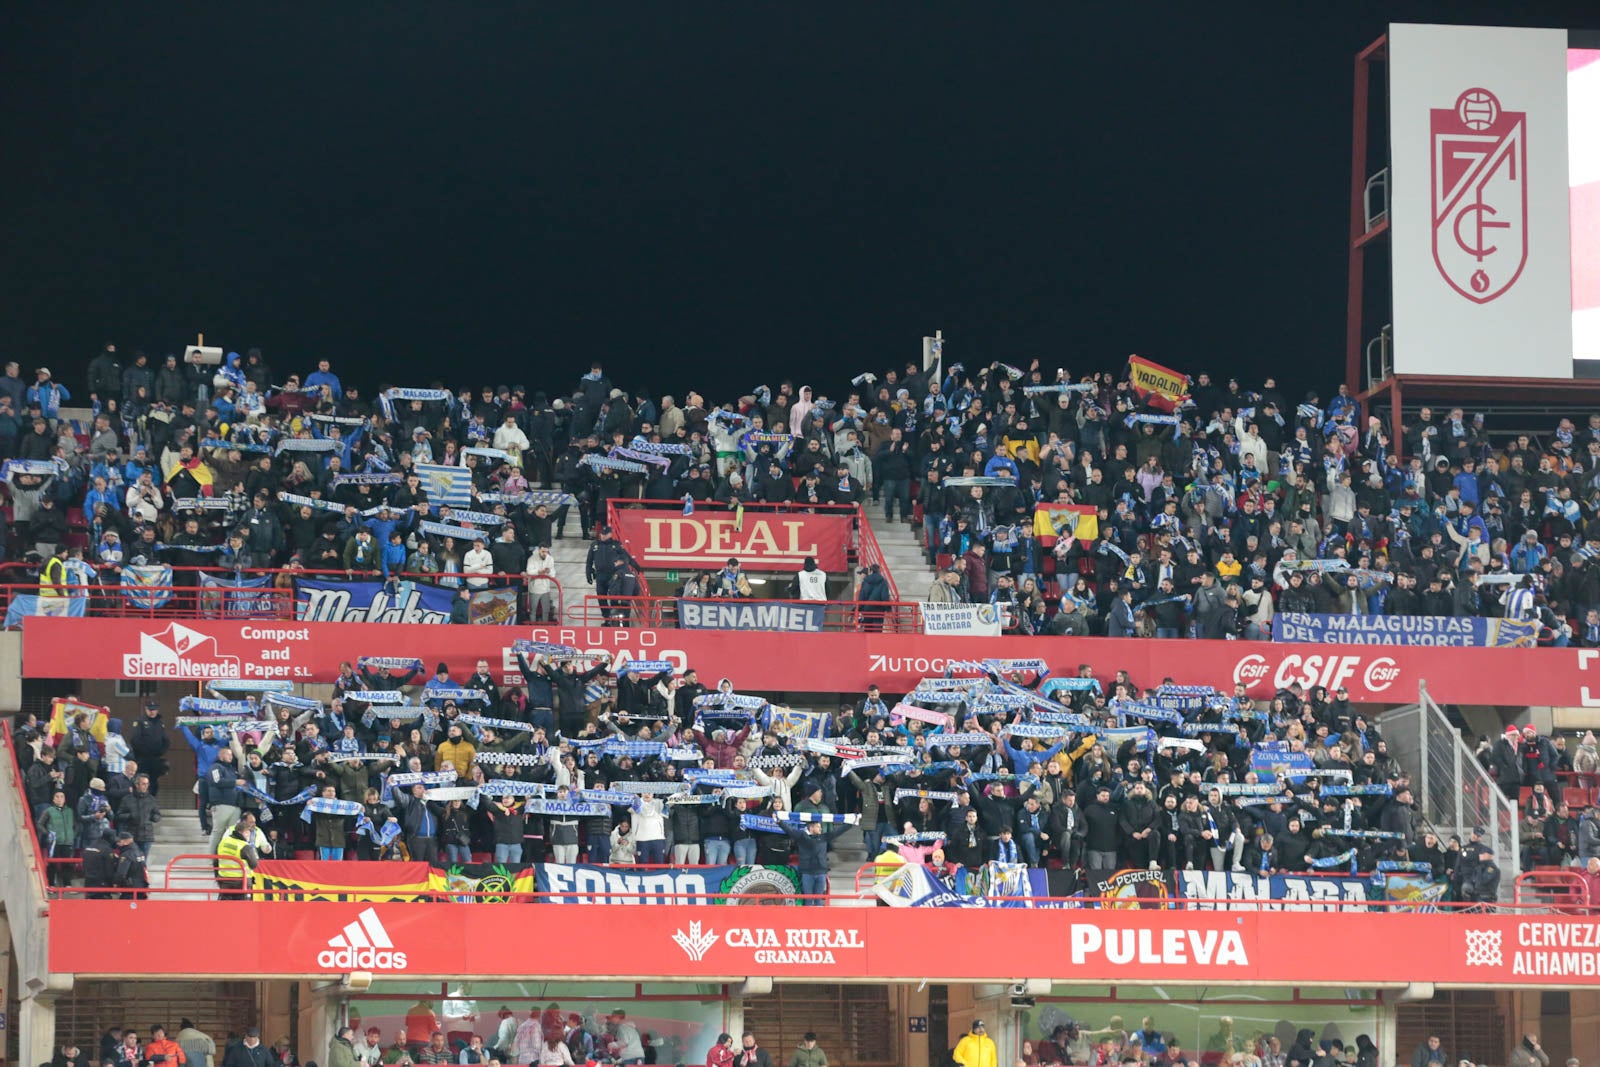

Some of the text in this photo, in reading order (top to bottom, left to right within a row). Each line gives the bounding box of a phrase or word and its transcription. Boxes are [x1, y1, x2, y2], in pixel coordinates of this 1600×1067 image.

[750, 434, 790, 442] BENAMIEL
[456, 511, 497, 524] MALAGA
[644, 518, 818, 557] IDEAL
[684, 604, 819, 632] BENAMIEL
[945, 612, 972, 621] PEDRO
[1282, 612, 1474, 633] PEÑA MALAGUISTAS
[241, 626, 309, 643] Compost
[533, 629, 657, 647] GRUPO
[1283, 624, 1320, 642] DEL
[261, 647, 290, 660] and
[128, 657, 238, 677] Sierra Nevada
[245, 663, 290, 678] Paper
[1240, 665, 1270, 678] CSIF
[1273, 654, 1361, 691] CSIF
[1371, 668, 1401, 680] CSIF
[356, 692, 384, 700] MALAGA
[915, 692, 961, 701] MALAGA
[200, 701, 242, 711] MALAGA
[1128, 704, 1165, 717] MALAGA
[1036, 713, 1079, 723] MALAGA
[1012, 725, 1060, 736] MALAGA
[1257, 752, 1280, 761] ZONA
[545, 802, 591, 813] MALAGA
[544, 864, 707, 905] FONDO
[1097, 870, 1167, 892] EL PERCHEL
[725, 929, 865, 949] CAJA RURAL
[1070, 923, 1249, 966] PULEVA
[317, 946, 408, 969] adidas
[754, 950, 836, 964] GRANADA
